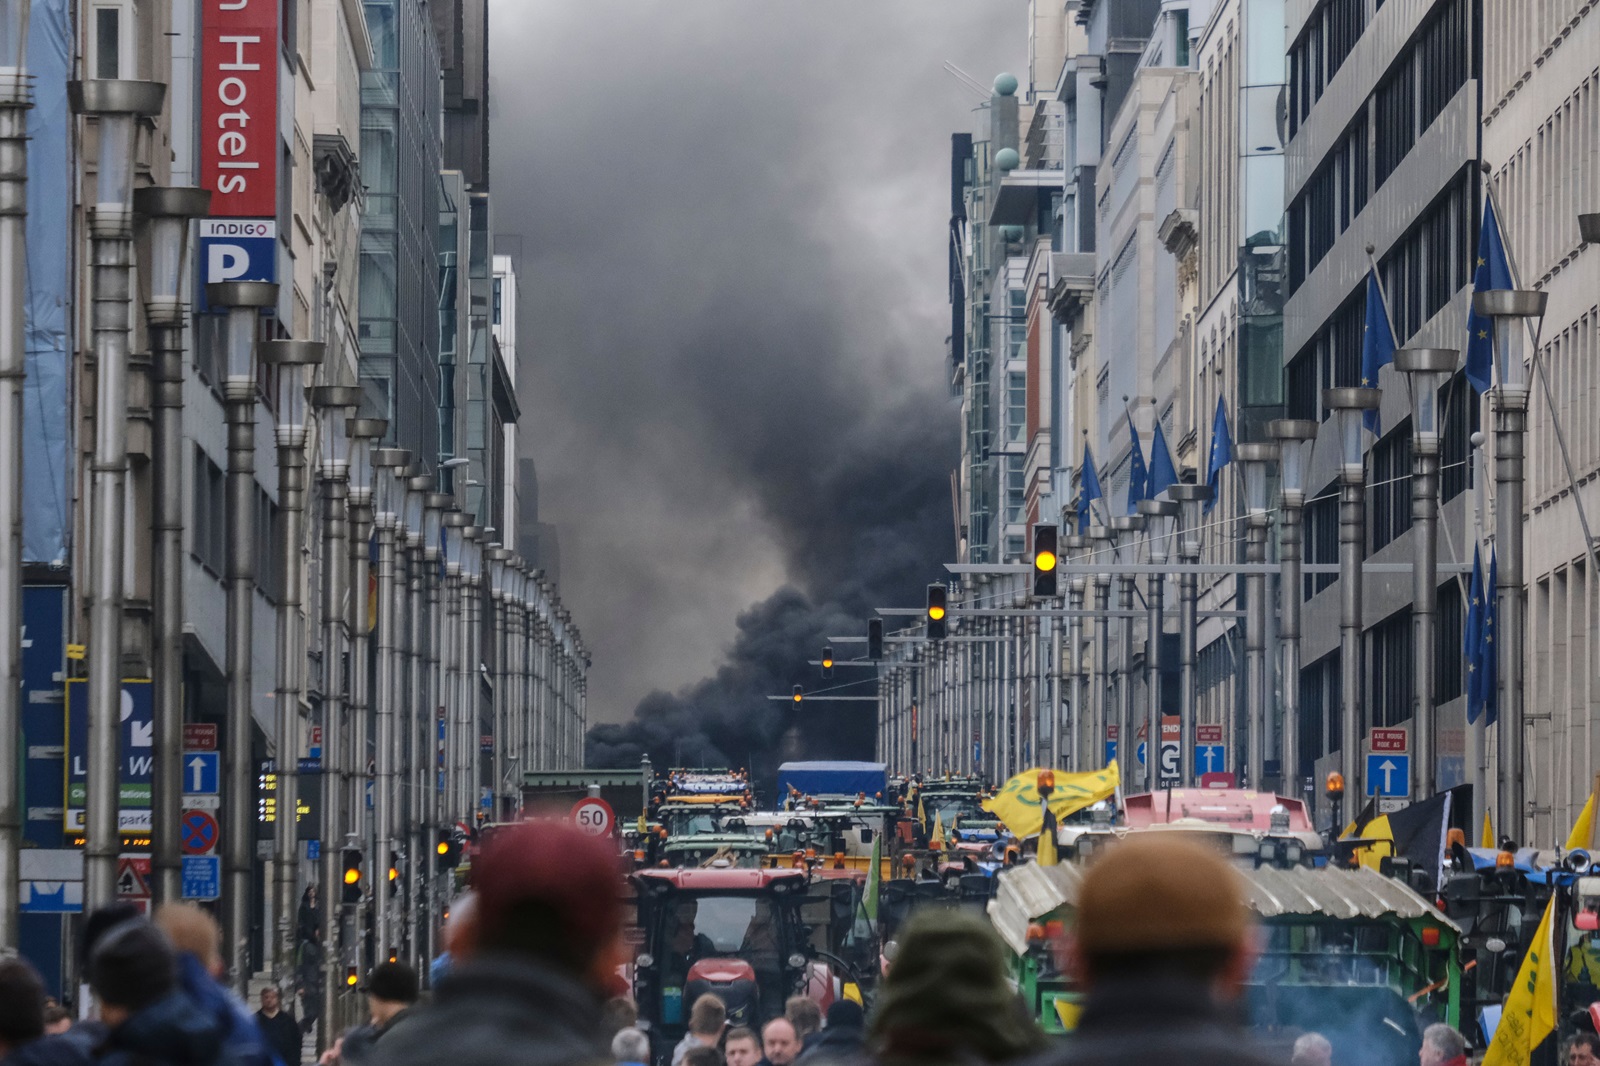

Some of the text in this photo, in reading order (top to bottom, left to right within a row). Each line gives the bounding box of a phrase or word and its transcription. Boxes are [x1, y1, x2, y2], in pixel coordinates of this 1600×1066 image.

[217, 35, 260, 194] Hotels
[210, 223, 267, 237] INDIGO
[208, 244, 250, 284] P
[1374, 732, 1403, 740] AXE ROUGE
[120, 788, 151, 800] tations
[580, 810, 604, 826] 50
